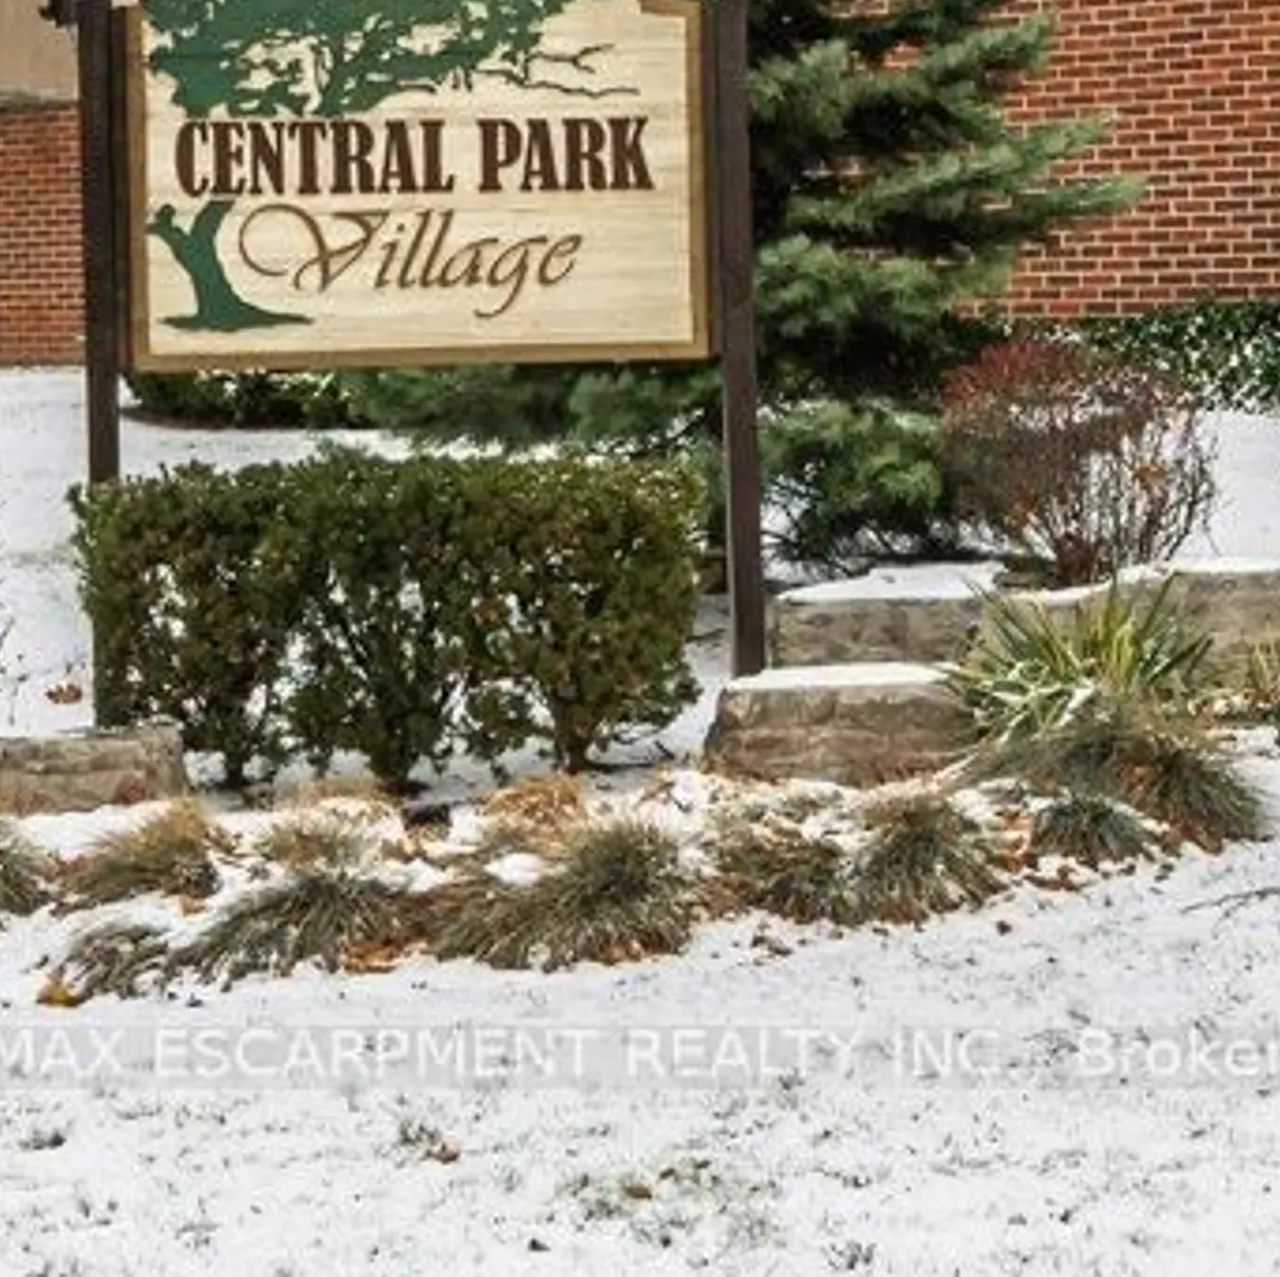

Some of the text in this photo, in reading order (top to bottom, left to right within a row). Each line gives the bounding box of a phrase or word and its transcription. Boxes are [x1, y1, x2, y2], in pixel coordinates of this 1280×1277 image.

[174, 115, 655, 197] CENTRAL PARK
[238, 203, 583, 319] Village
